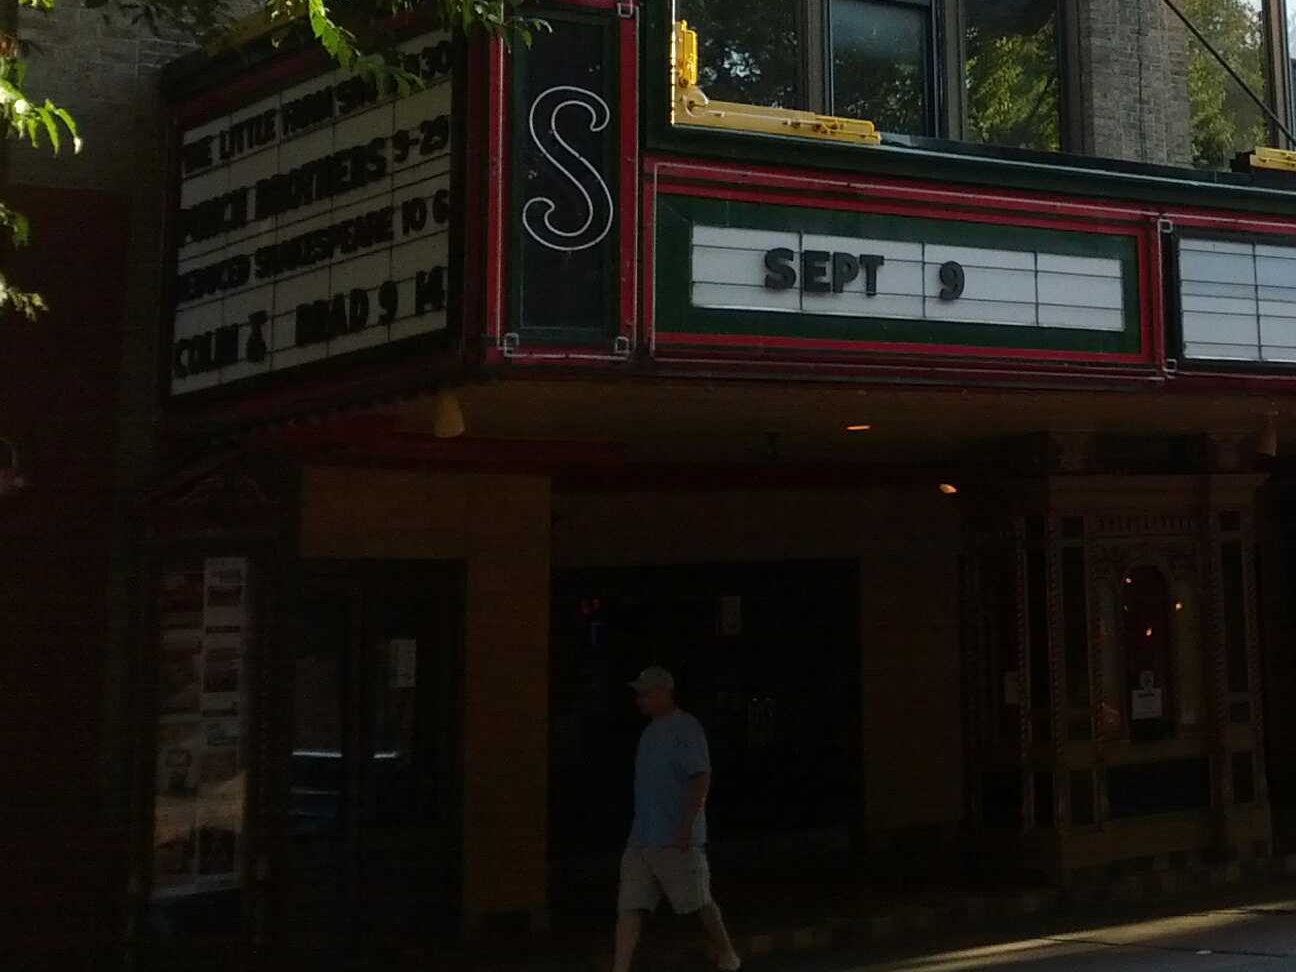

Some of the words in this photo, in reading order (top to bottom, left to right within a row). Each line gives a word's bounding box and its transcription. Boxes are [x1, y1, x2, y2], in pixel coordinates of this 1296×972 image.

[522, 84, 614, 251] S
[763, 246, 885, 297] SEPT
[938, 259, 966, 301] 9
[378, 279, 399, 325] 9
